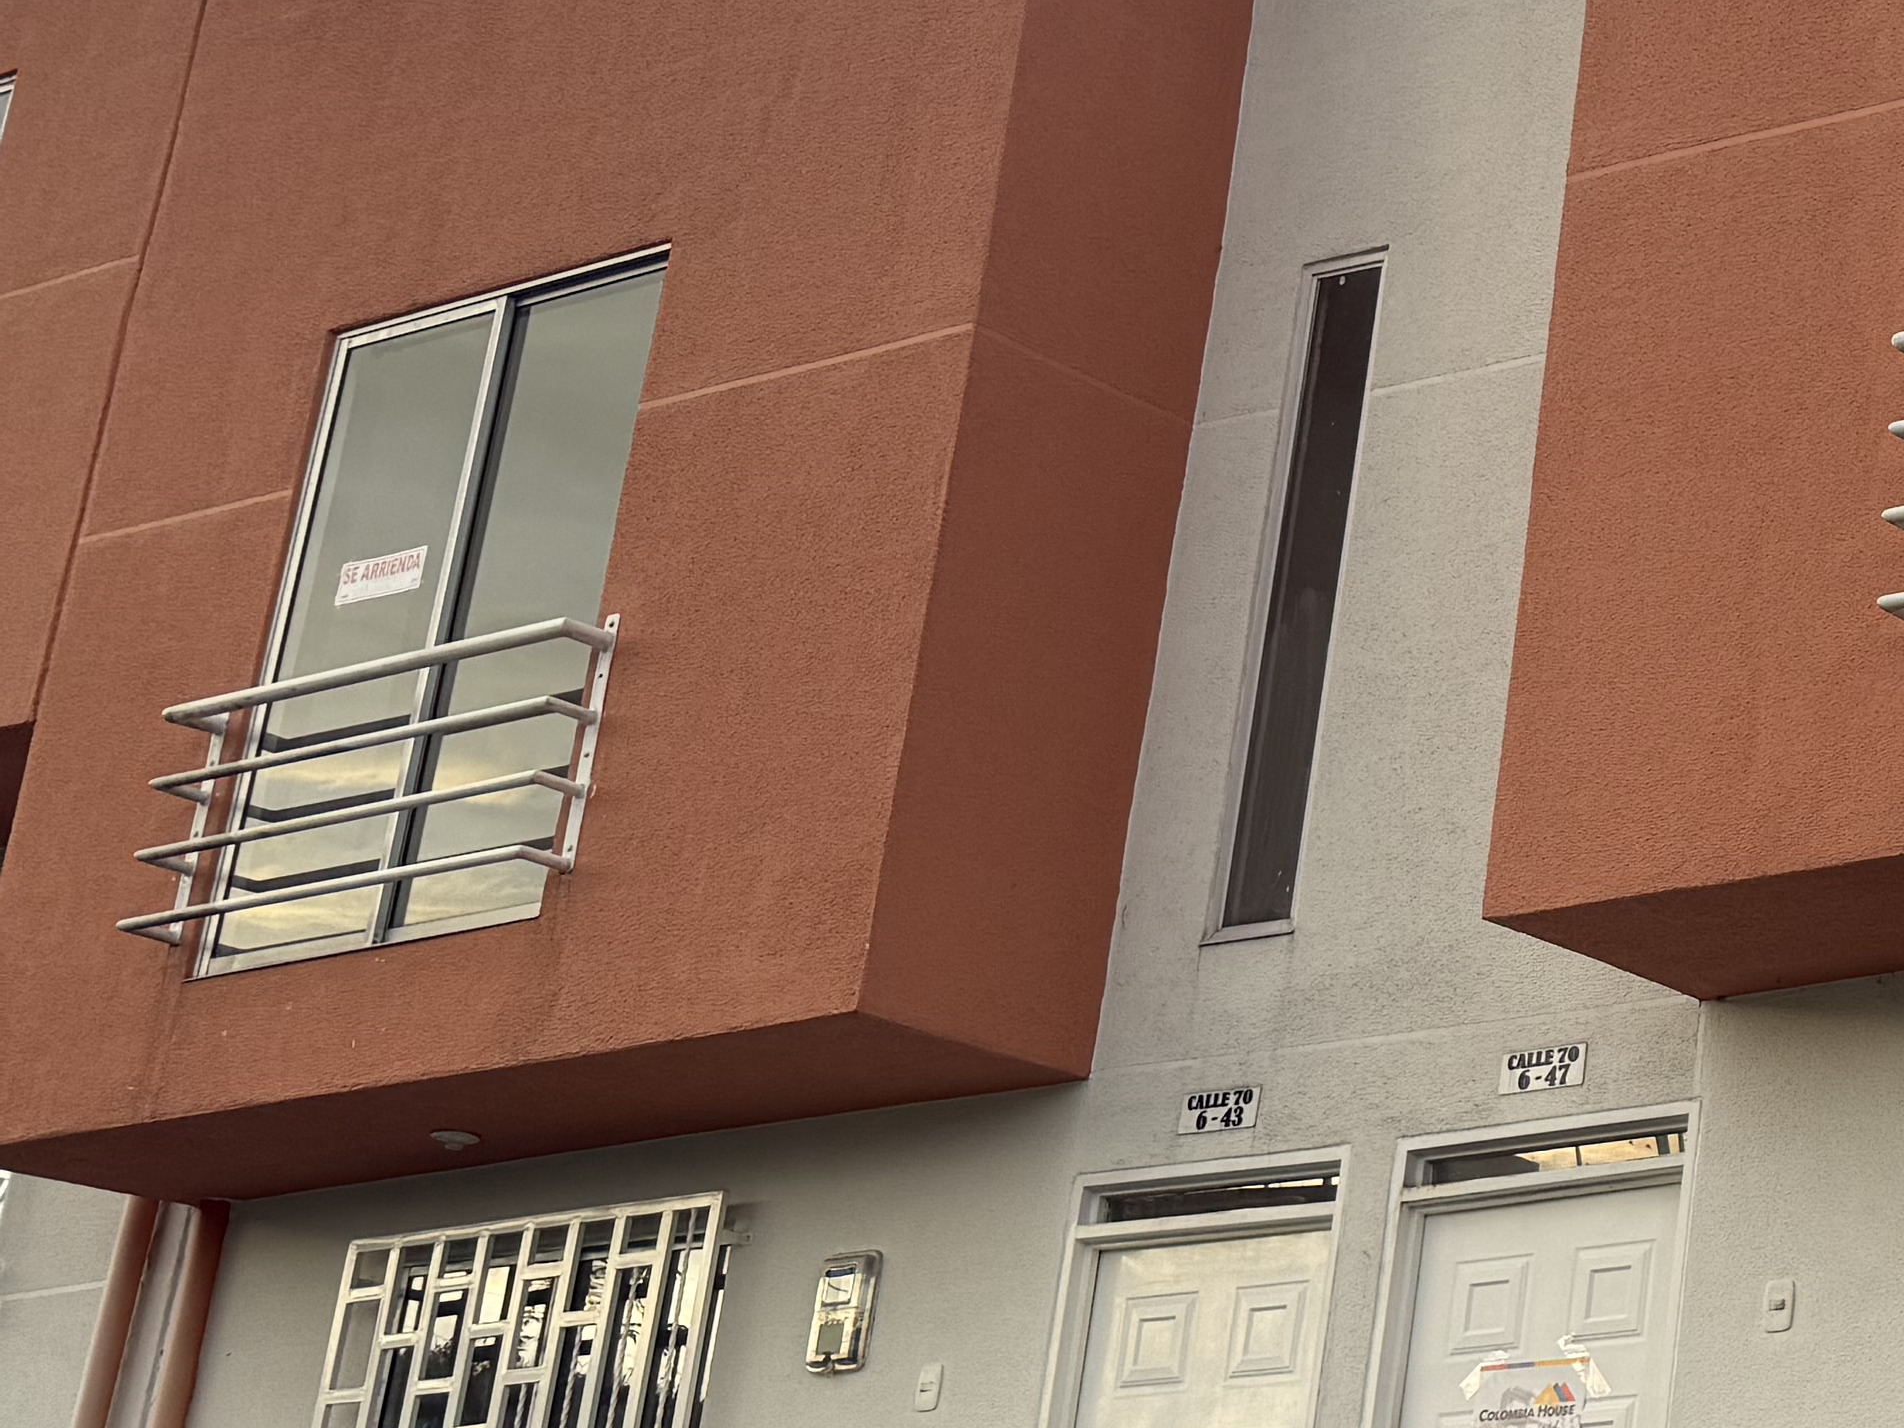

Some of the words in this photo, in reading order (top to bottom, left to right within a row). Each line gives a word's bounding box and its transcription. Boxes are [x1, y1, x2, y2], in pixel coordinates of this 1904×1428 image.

[343, 566, 360, 585] SE
[360, 552, 421, 582] ARRIENDA
[1508, 1049, 1554, 1070] CALLE
[1557, 1045, 1580, 1063] 70
[1187, 1092, 1231, 1111] CALLE
[1233, 1089, 1254, 1105] 70
[1479, 1408, 1535, 1422] COLOMBIA
[1537, 1404, 1576, 1418] HOUSE
